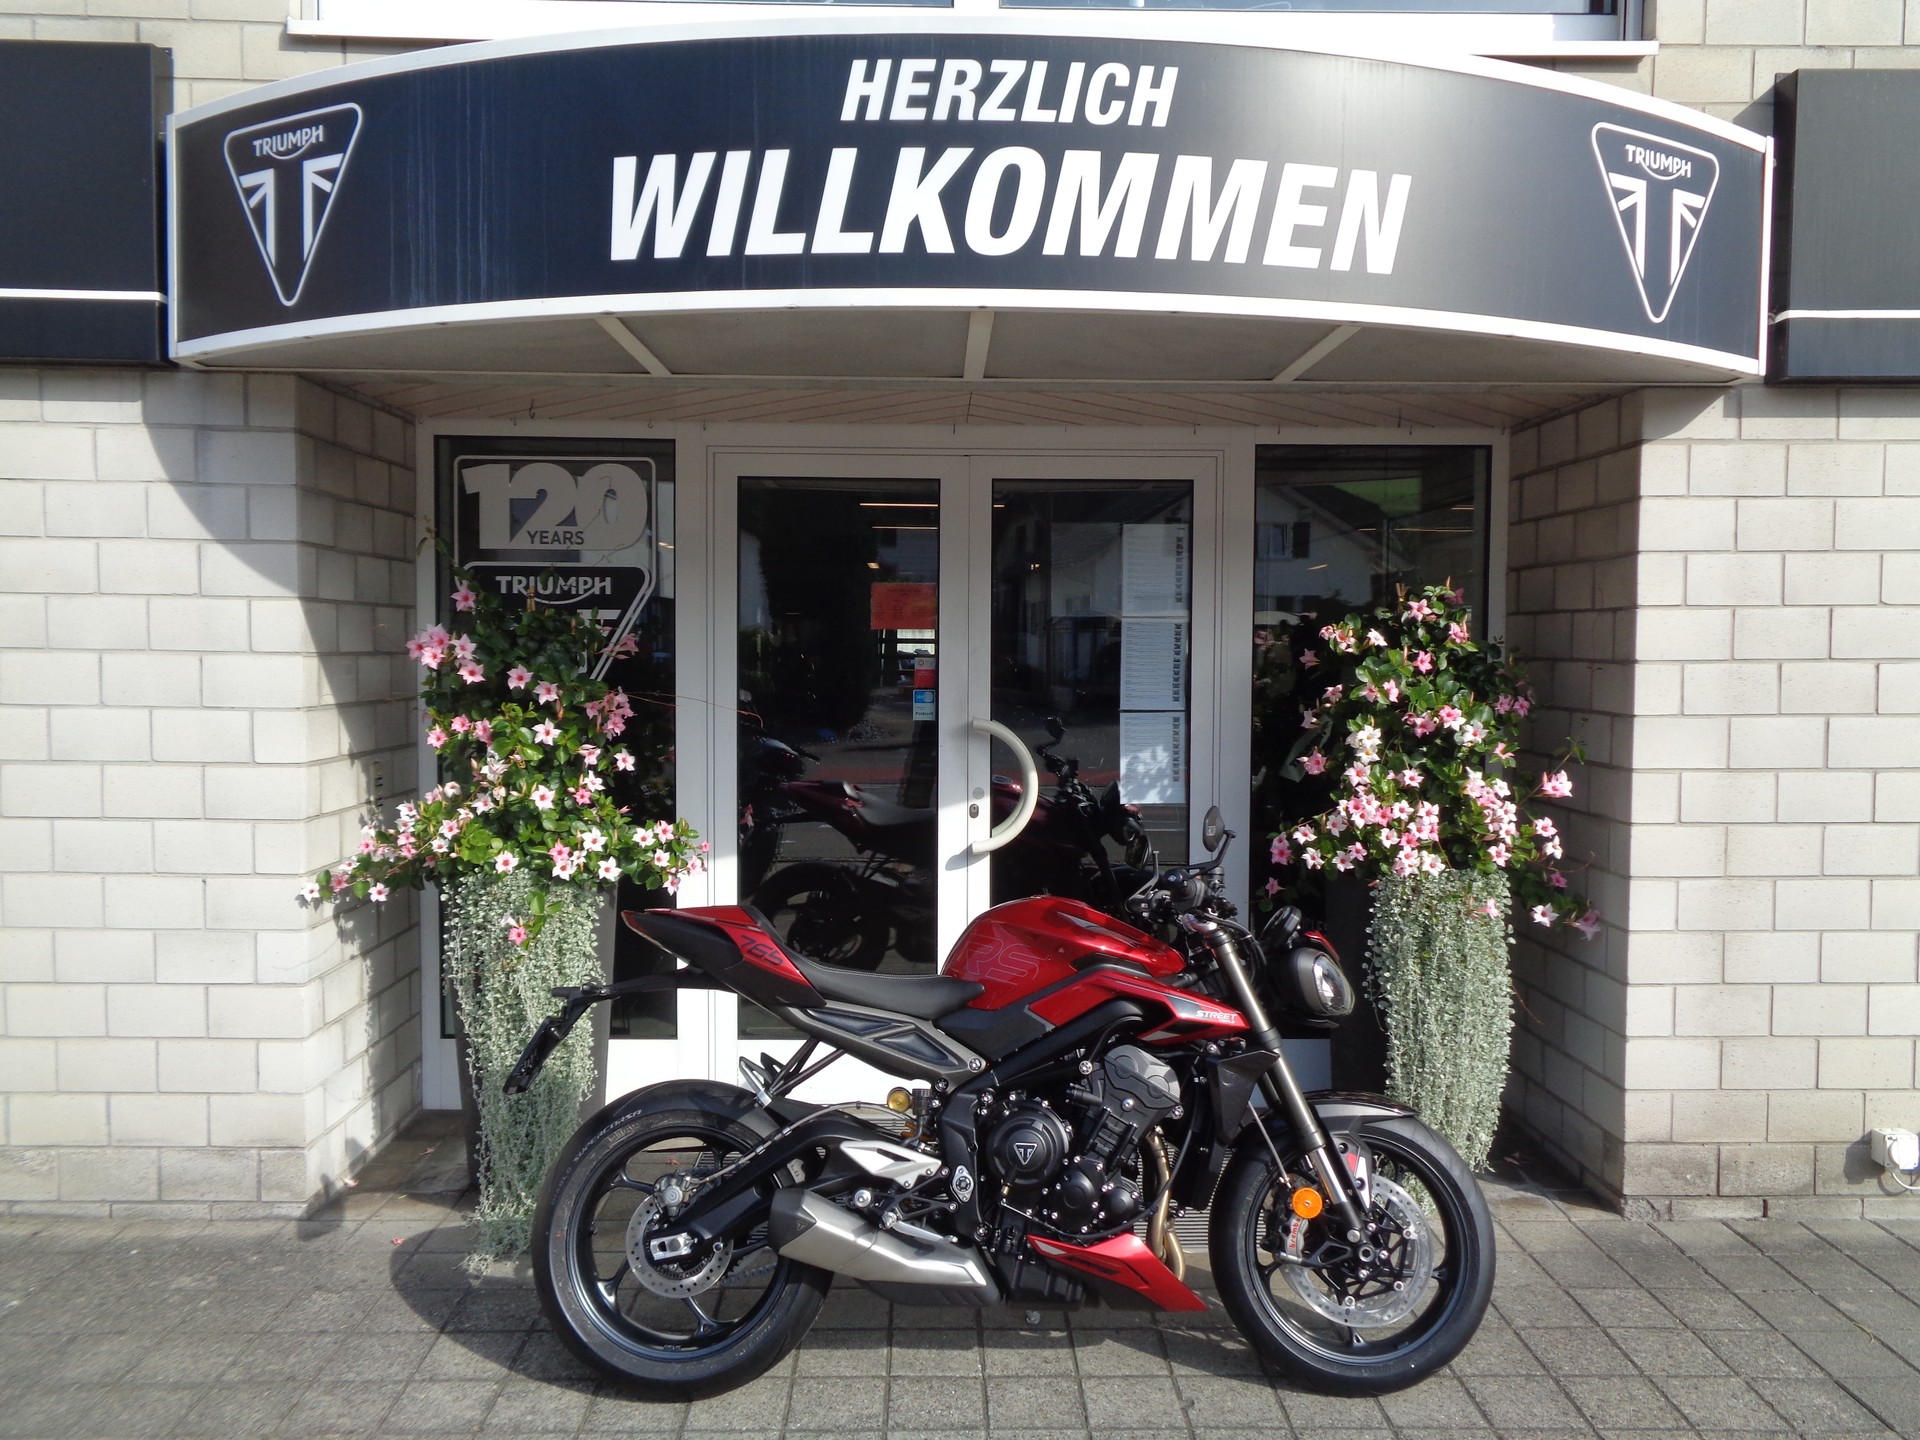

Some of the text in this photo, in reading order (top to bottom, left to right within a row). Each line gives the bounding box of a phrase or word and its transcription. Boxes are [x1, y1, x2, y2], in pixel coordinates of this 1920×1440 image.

[839, 58, 1178, 127] HERZLICH
[252, 124, 324, 159] TRIUMPH
[1624, 144, 1692, 180] TRIUMPH
[609, 146, 1413, 275] WILLKOMMEN
[461, 462, 648, 550] 120
[527, 530, 585, 545] YEARS
[495, 575, 612, 604] TRIUMPH
[741, 934, 784, 965] 765
[965, 933, 1050, 985] RS
[1196, 1010, 1238, 1020] STREET
